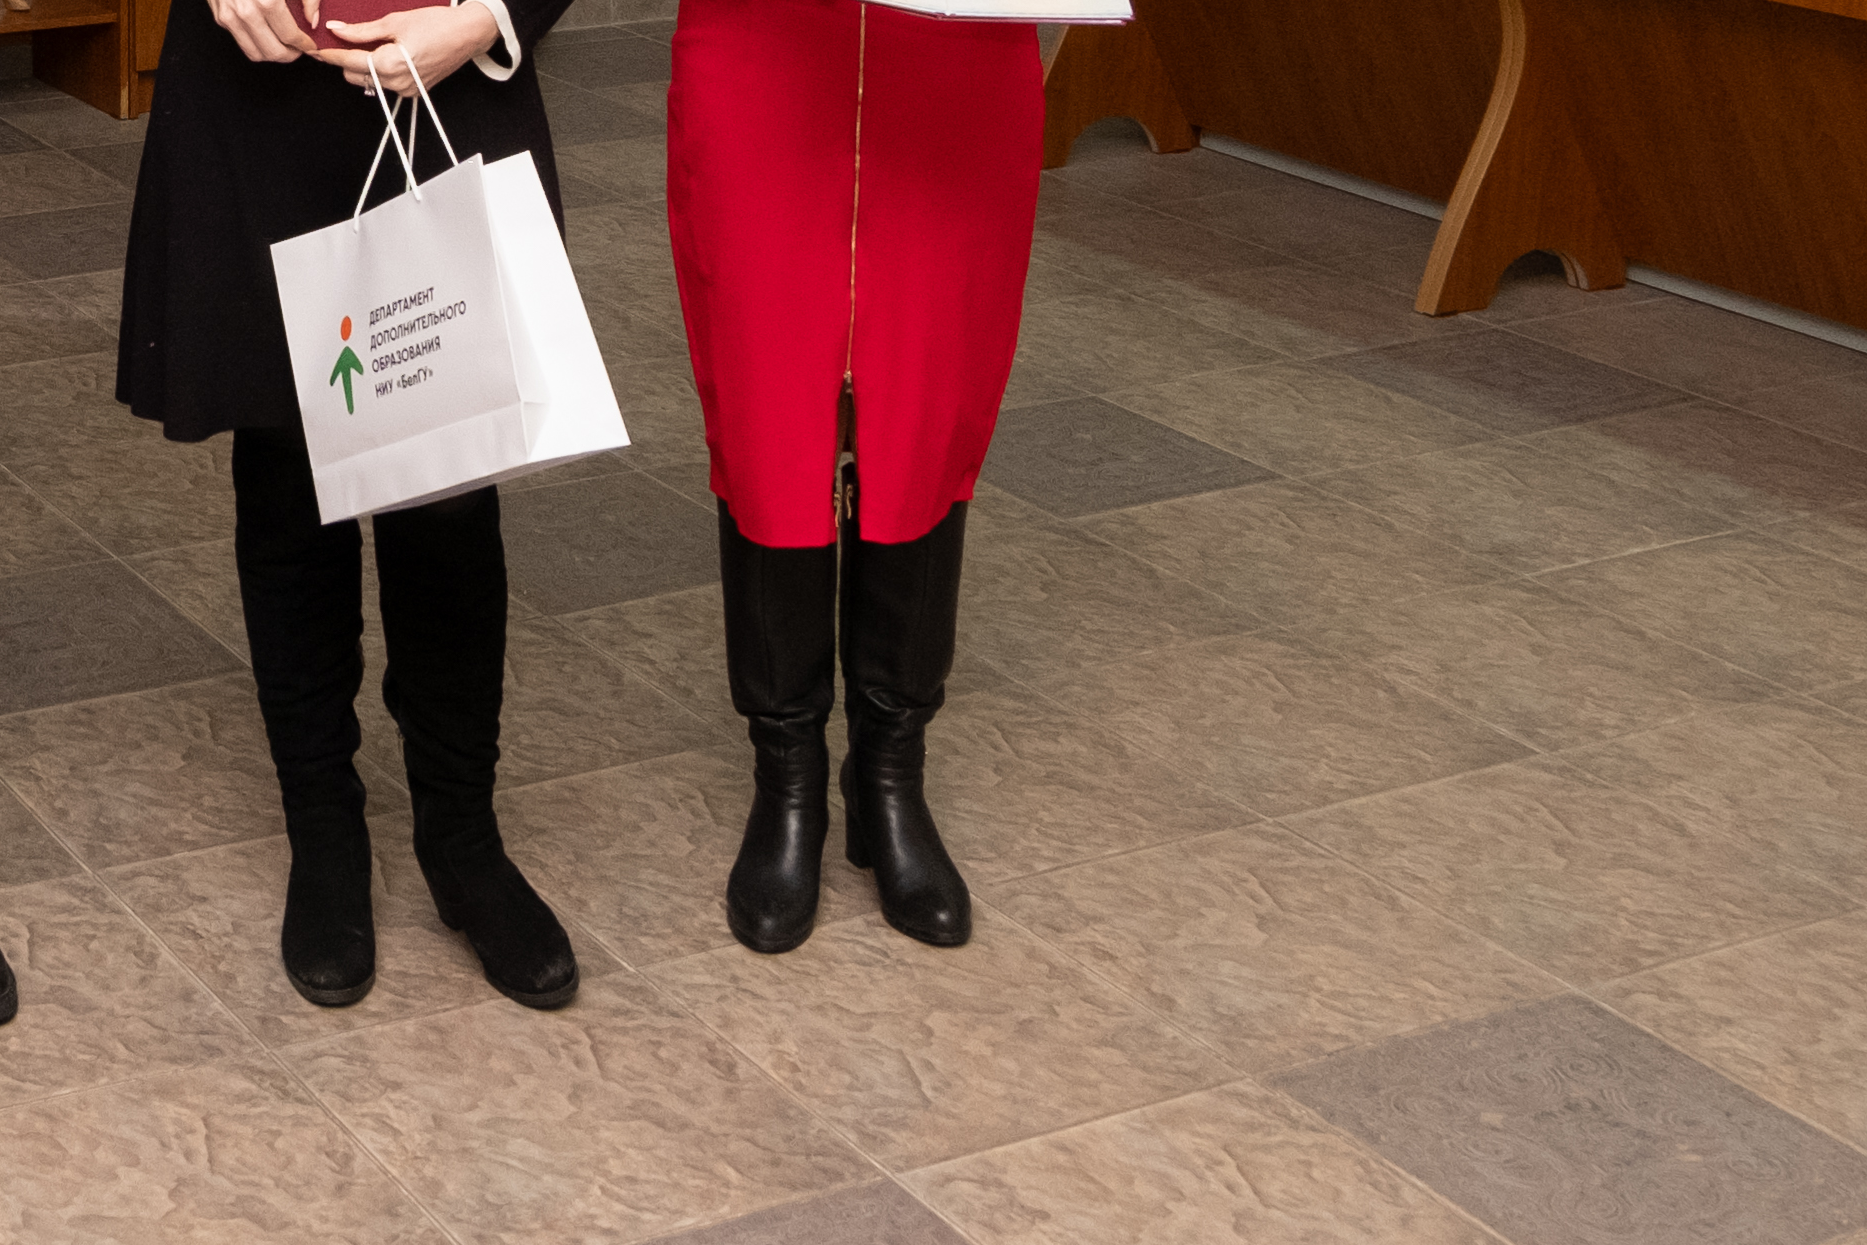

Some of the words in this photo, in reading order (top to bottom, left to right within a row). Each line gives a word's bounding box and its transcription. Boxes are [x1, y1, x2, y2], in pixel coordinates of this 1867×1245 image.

[369, 286, 435, 328] ДЕПАРТАМЕНТ
[370, 300, 467, 352] ДОПОЛНИТЕЛЬНОГО
[371, 335, 442, 373] ОБРАЗОВАНИЯ
[375, 378, 393, 399] НИУ
[396, 366, 434, 389] «БелГУ»
